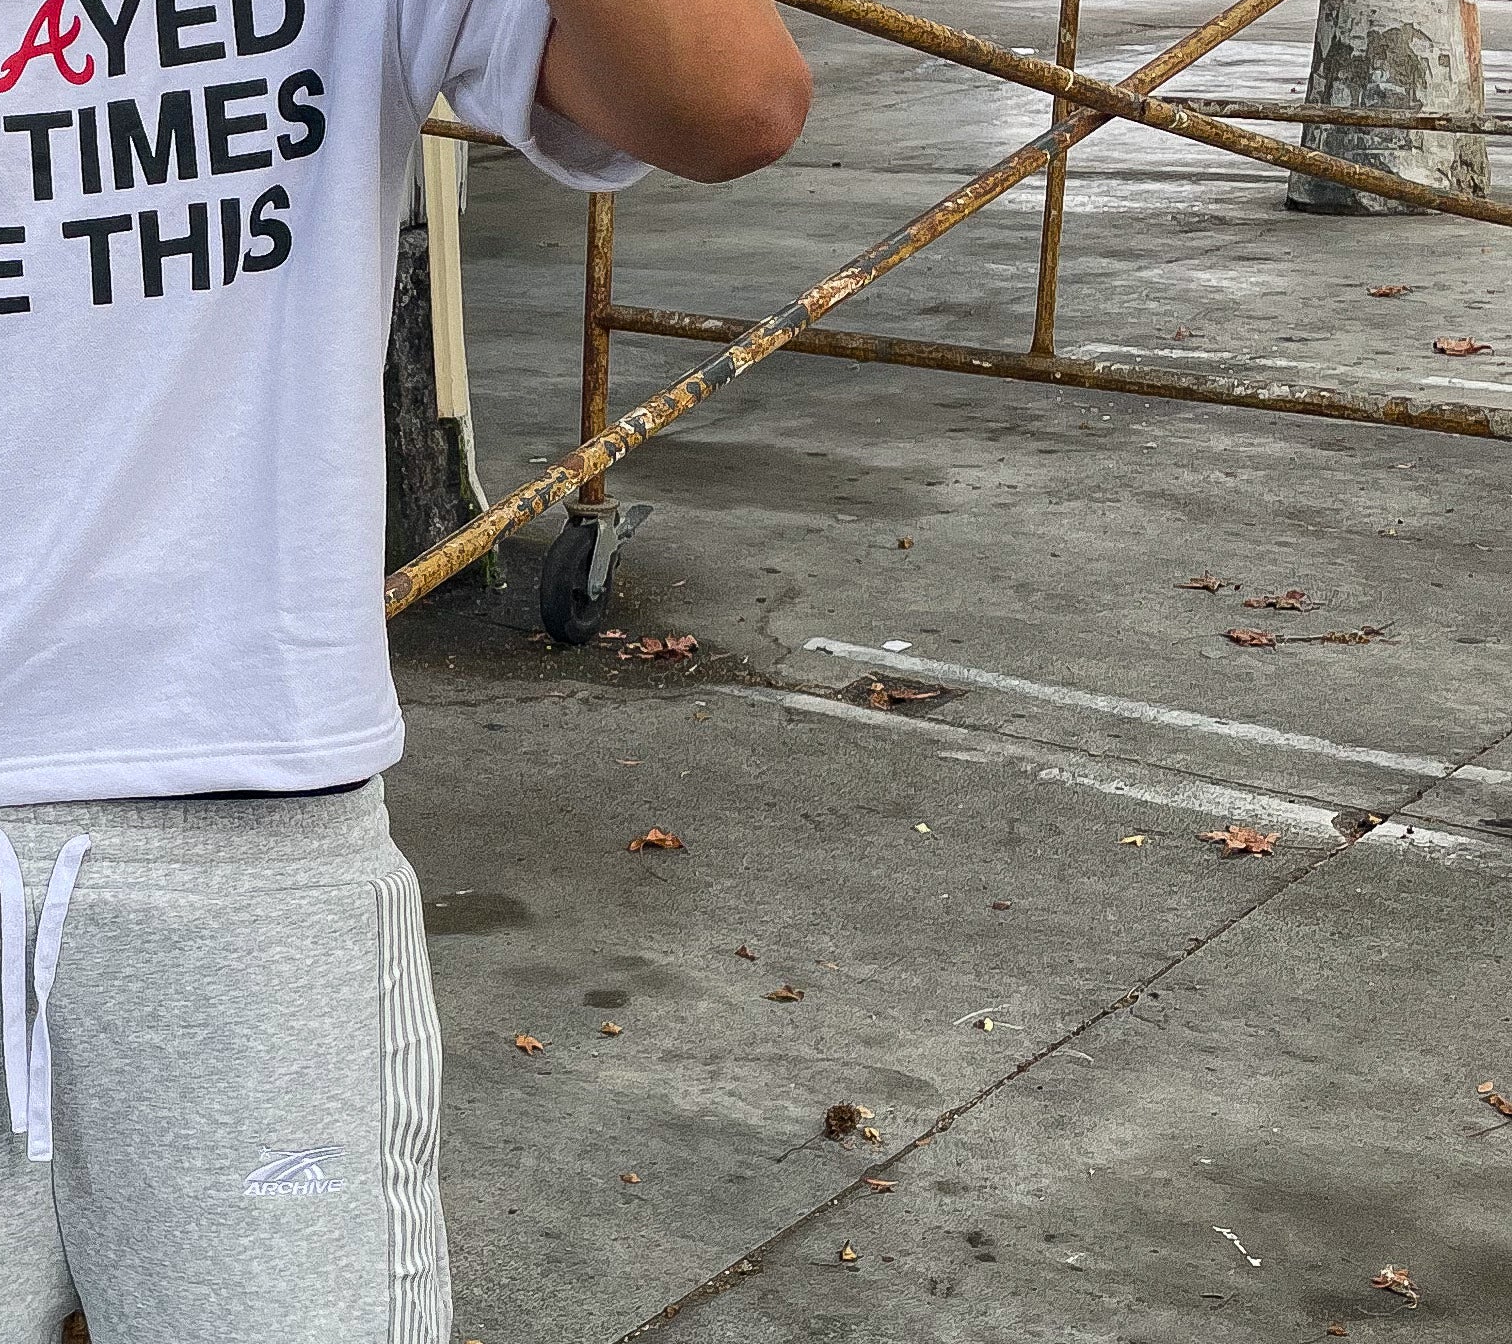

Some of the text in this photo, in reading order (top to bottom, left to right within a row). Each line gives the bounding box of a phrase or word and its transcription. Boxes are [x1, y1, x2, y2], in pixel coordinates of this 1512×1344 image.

[3, 68, 327, 202] TIMES
[62, 183, 293, 306] THIS
[243, 1178, 345, 1196] ARCHIVE
